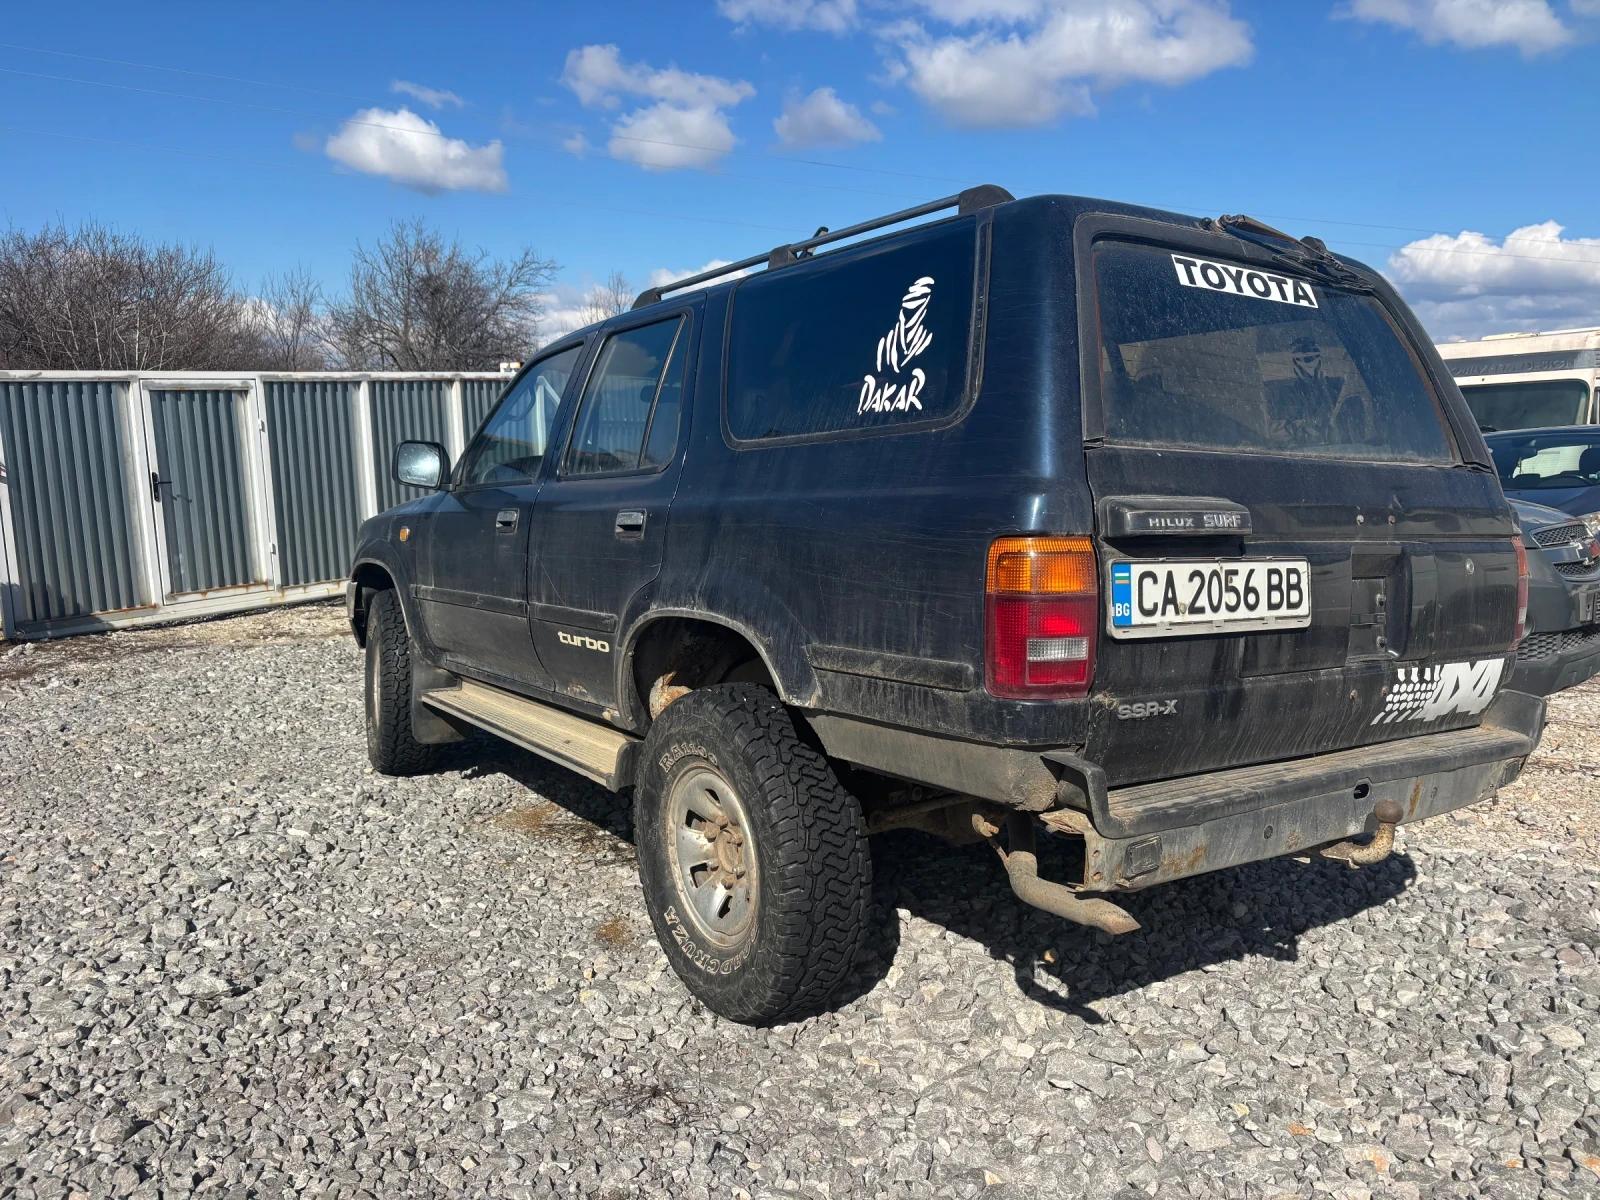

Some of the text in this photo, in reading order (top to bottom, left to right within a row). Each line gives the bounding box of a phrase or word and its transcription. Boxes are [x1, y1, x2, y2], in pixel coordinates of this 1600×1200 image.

[1175, 257, 1316, 306] TOYOTA
[857, 368, 925, 415] DAKAR
[1149, 513, 1241, 528] HILUX SURF
[1137, 567, 1303, 617] CA 2056 BB
[1115, 602, 1131, 617] BG
[557, 631, 610, 653] turbo
[1117, 699, 1178, 720] SSR-X
